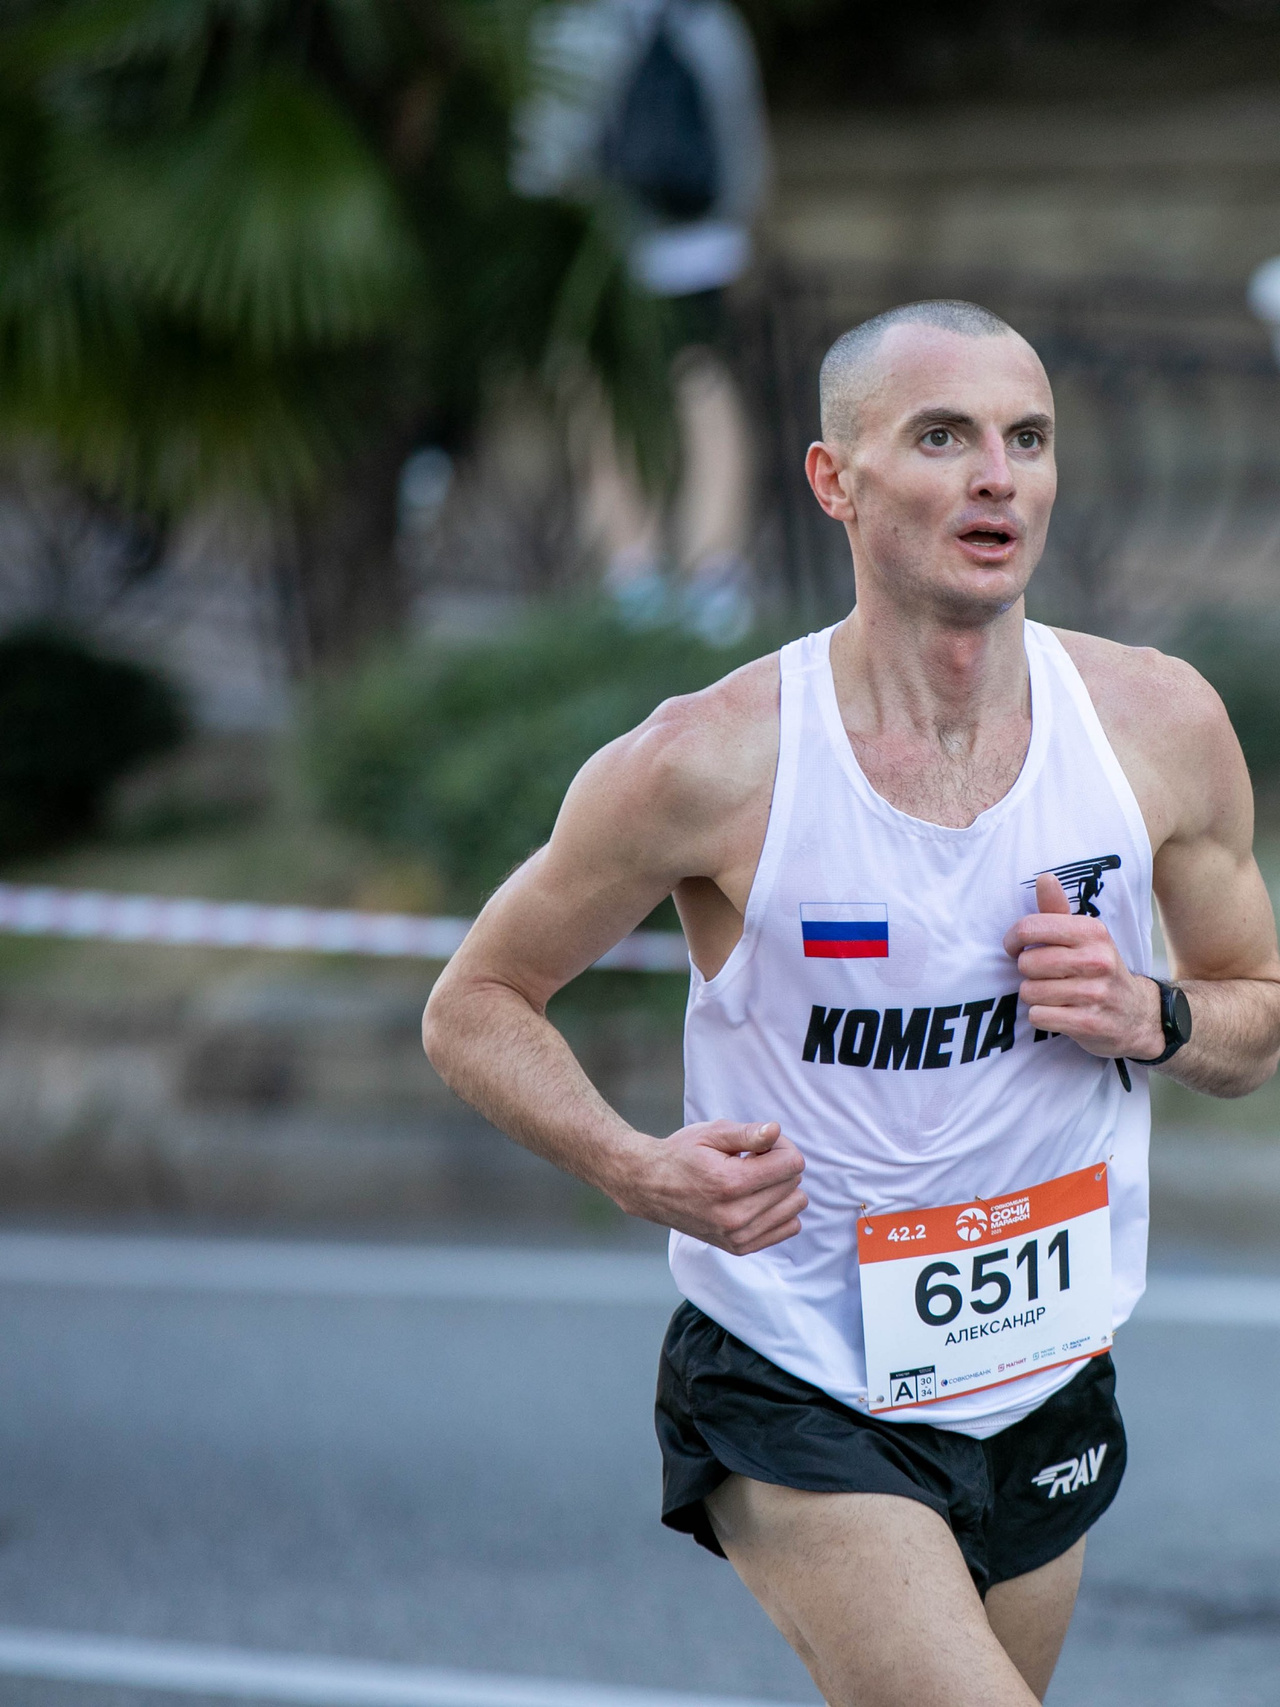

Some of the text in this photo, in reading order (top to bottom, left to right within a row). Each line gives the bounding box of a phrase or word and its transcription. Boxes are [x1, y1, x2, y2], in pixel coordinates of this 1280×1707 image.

[990, 1202, 1030, 1222] СОЧИ
[990, 1212, 1030, 1229] МАРАФОН
[887, 1224, 927, 1242] 42.2
[915, 1229, 1070, 1327] 6511
[944, 1306, 1046, 1346] АЛЕКСАНДР
[920, 1376, 932, 1386] 30
[948, 1368, 992, 1385] СОВКОМБАНК
[920, 1388, 933, 1397] 34
[1031, 1443, 1107, 1499] RAY
